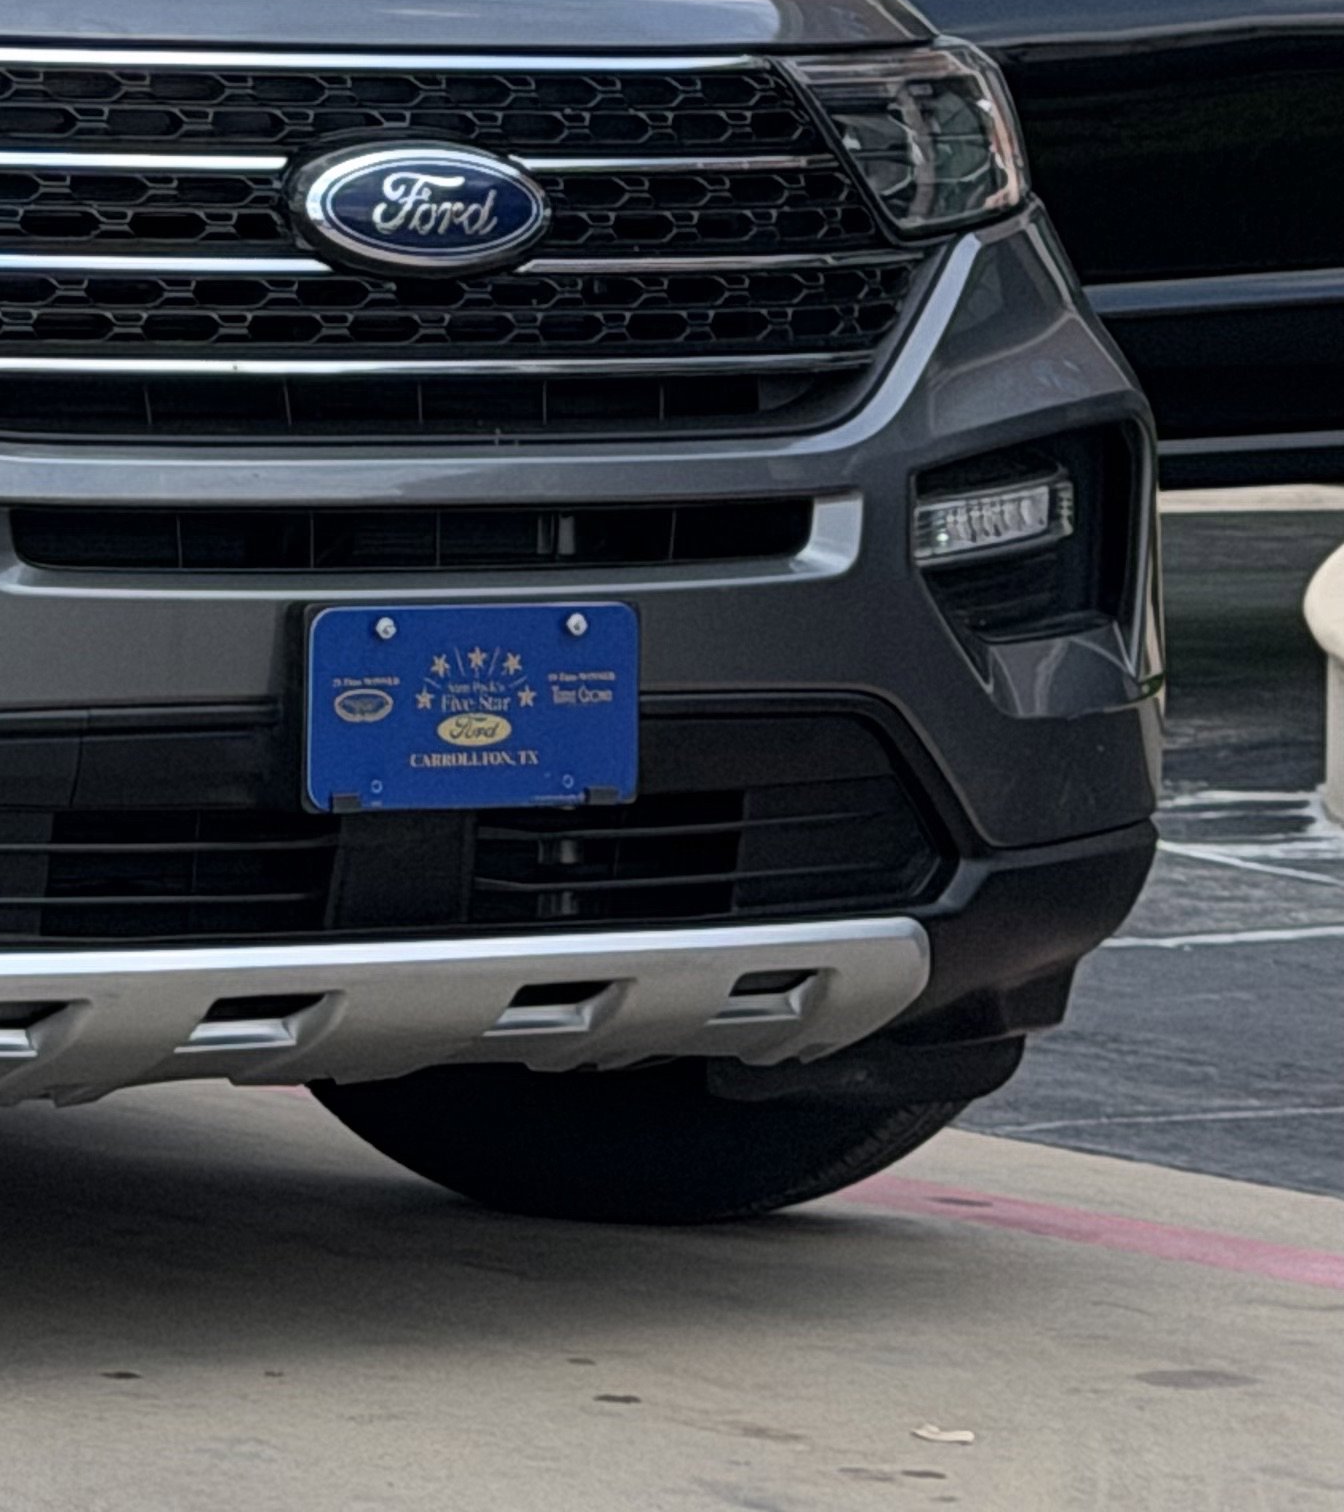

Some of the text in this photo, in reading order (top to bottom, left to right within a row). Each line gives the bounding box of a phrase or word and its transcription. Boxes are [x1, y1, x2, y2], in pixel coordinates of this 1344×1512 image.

[371, 171, 499, 235] Ford
[478, 694, 512, 712] Star
[450, 715, 501, 740] Ford
[517, 749, 539, 766] TX
